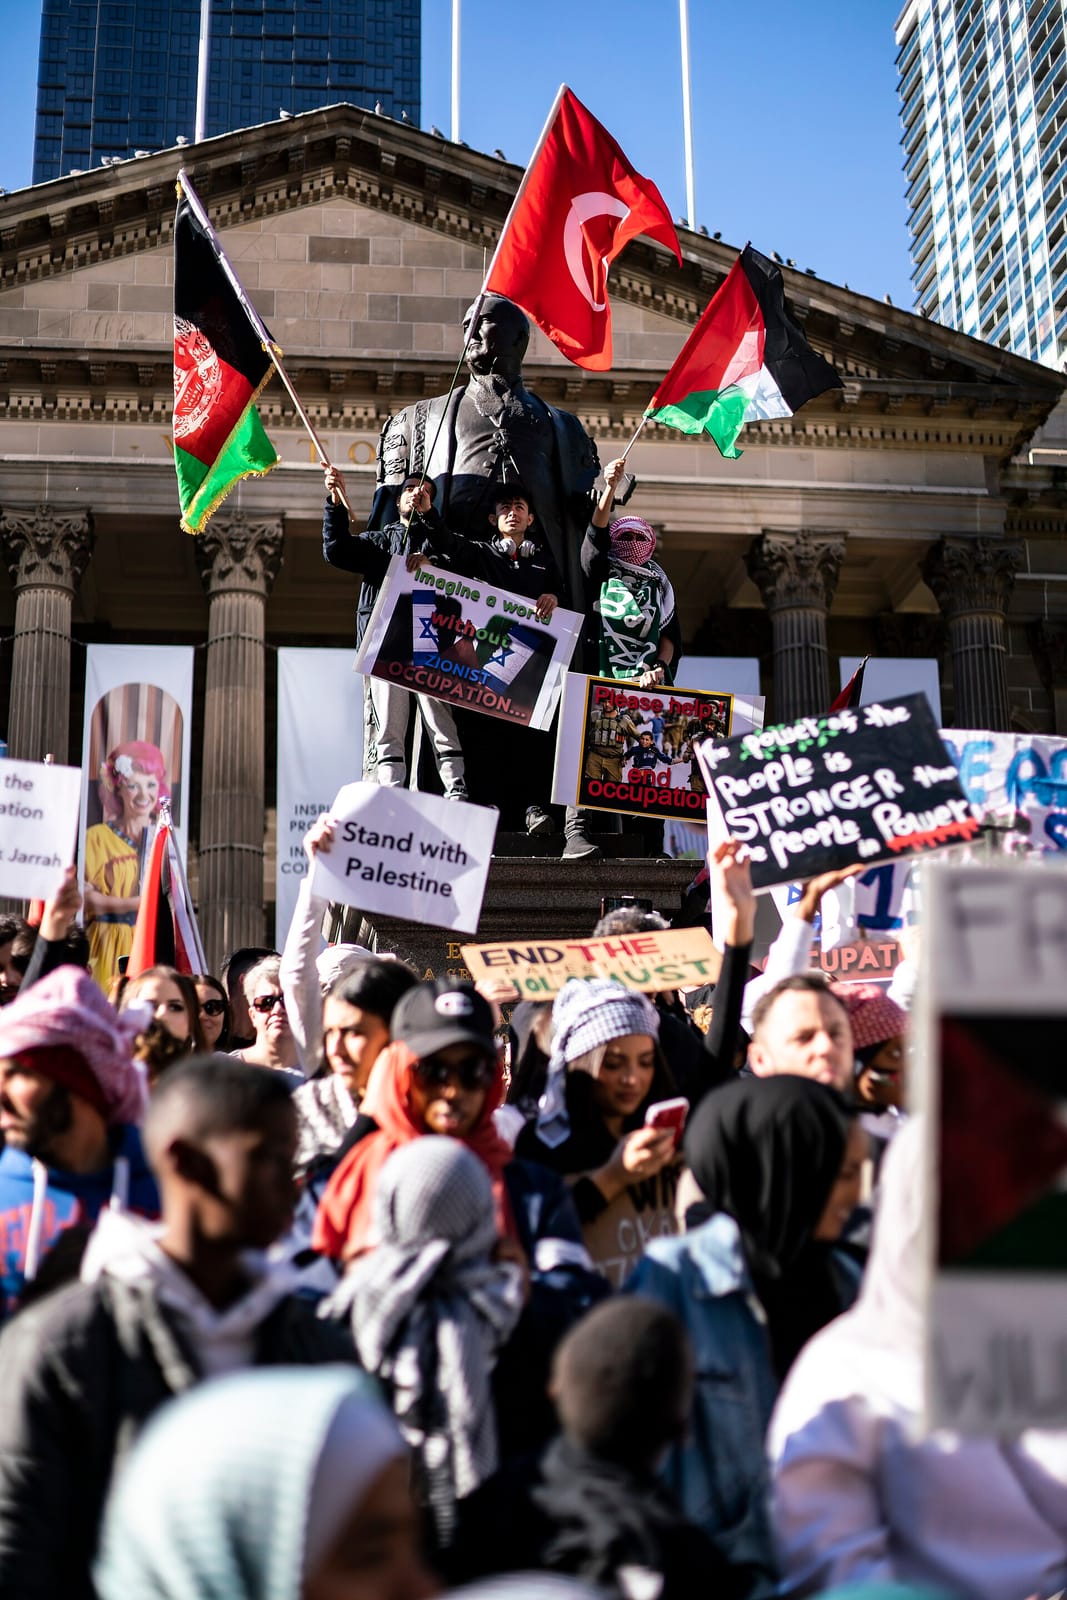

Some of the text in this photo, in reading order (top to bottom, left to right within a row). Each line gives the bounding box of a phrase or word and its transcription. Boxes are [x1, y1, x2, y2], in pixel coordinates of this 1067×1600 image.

[415, 567, 480, 602] Imagine
[486, 595, 497, 608] a
[431, 611, 513, 648] without
[424, 654, 490, 685] ZIONIST
[388, 661, 527, 719] OCCUPATION...
[594, 686, 664, 714] Please
[5, 773, 34, 792] the
[627, 766, 672, 788] end
[8, 848, 62, 868] Jarrah
[342, 821, 468, 866] Stand with
[345, 857, 453, 898] Palestine
[480, 937, 660, 967] END THE
